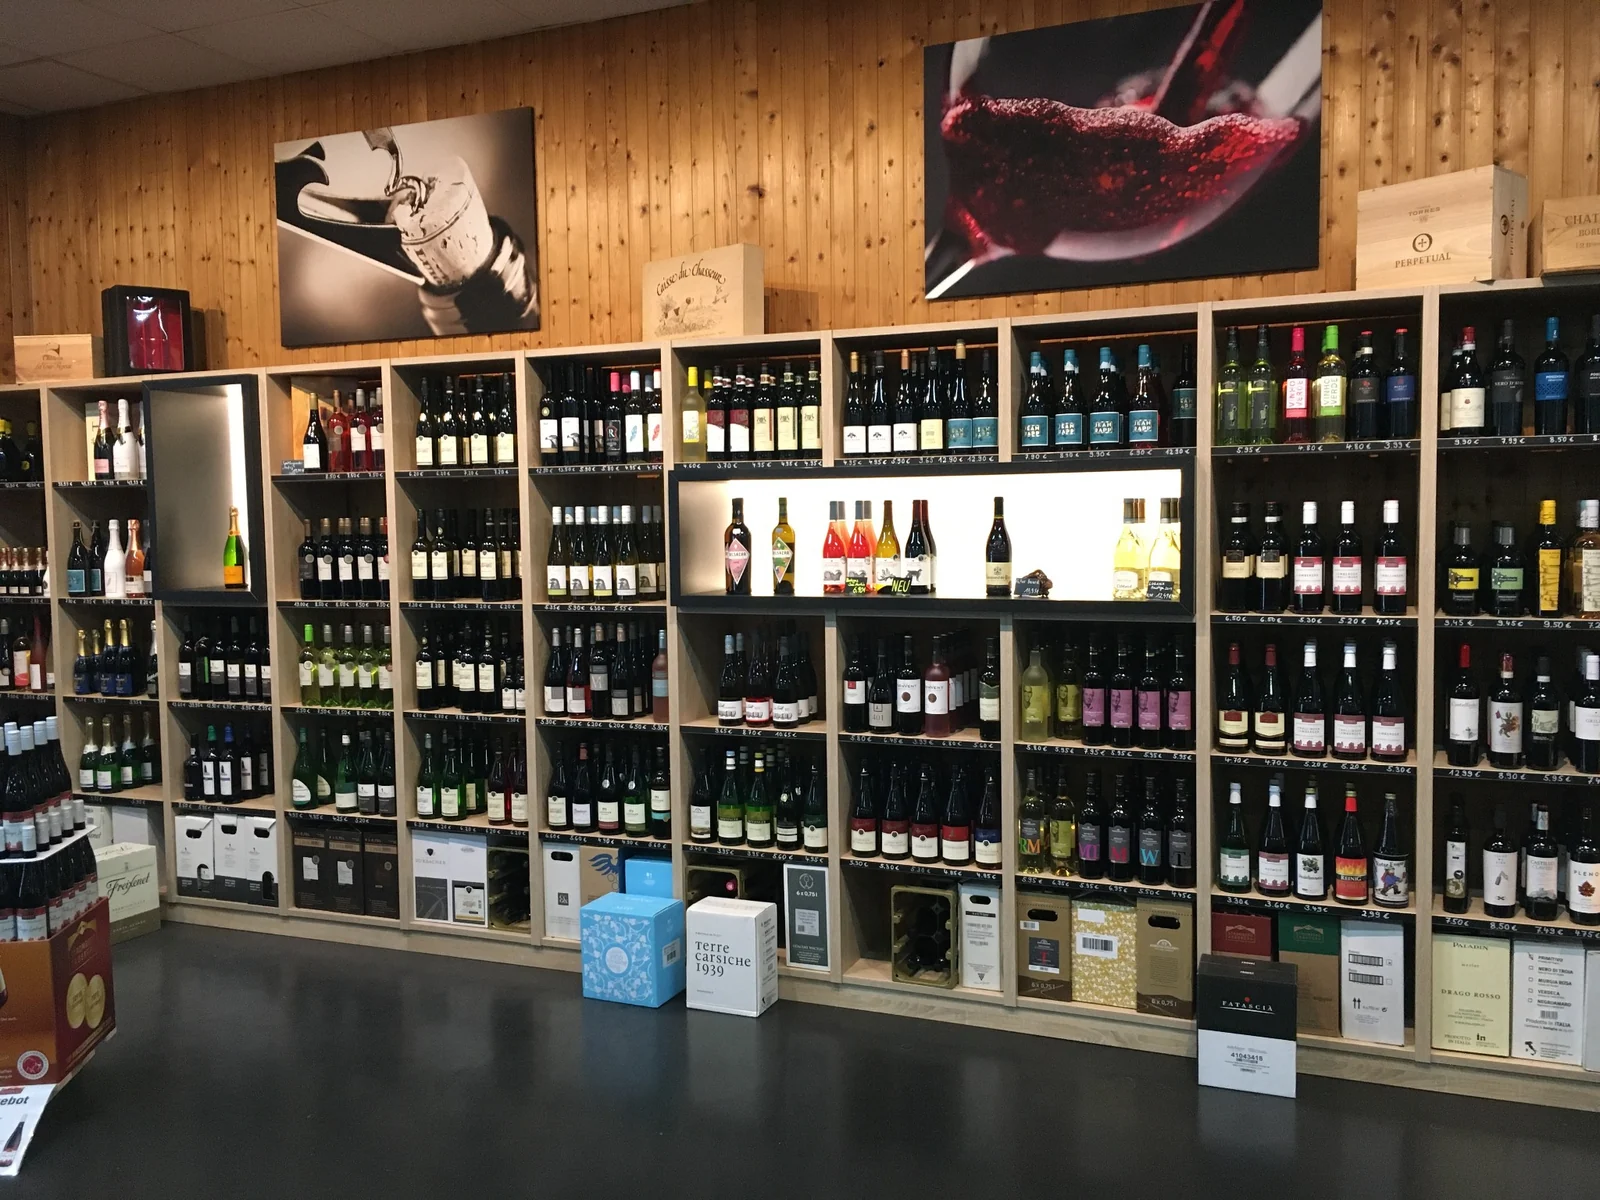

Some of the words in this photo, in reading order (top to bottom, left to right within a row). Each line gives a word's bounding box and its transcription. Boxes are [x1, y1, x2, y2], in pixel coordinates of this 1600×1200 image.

[1408, 207, 1441, 217] TORRES
[1395, 252, 1451, 268] PERPETUAL
[657, 273, 677, 296] Caisse
[679, 261, 691, 280] du
[692, 258, 726, 284] Chasseur
[891, 579, 911, 592] NEU
[106, 872, 150, 900] Freixenet
[696, 963, 724, 977] 1939
[1441, 988, 1471, 997] DRAGO
[1474, 992, 1501, 1000] ROSSO
